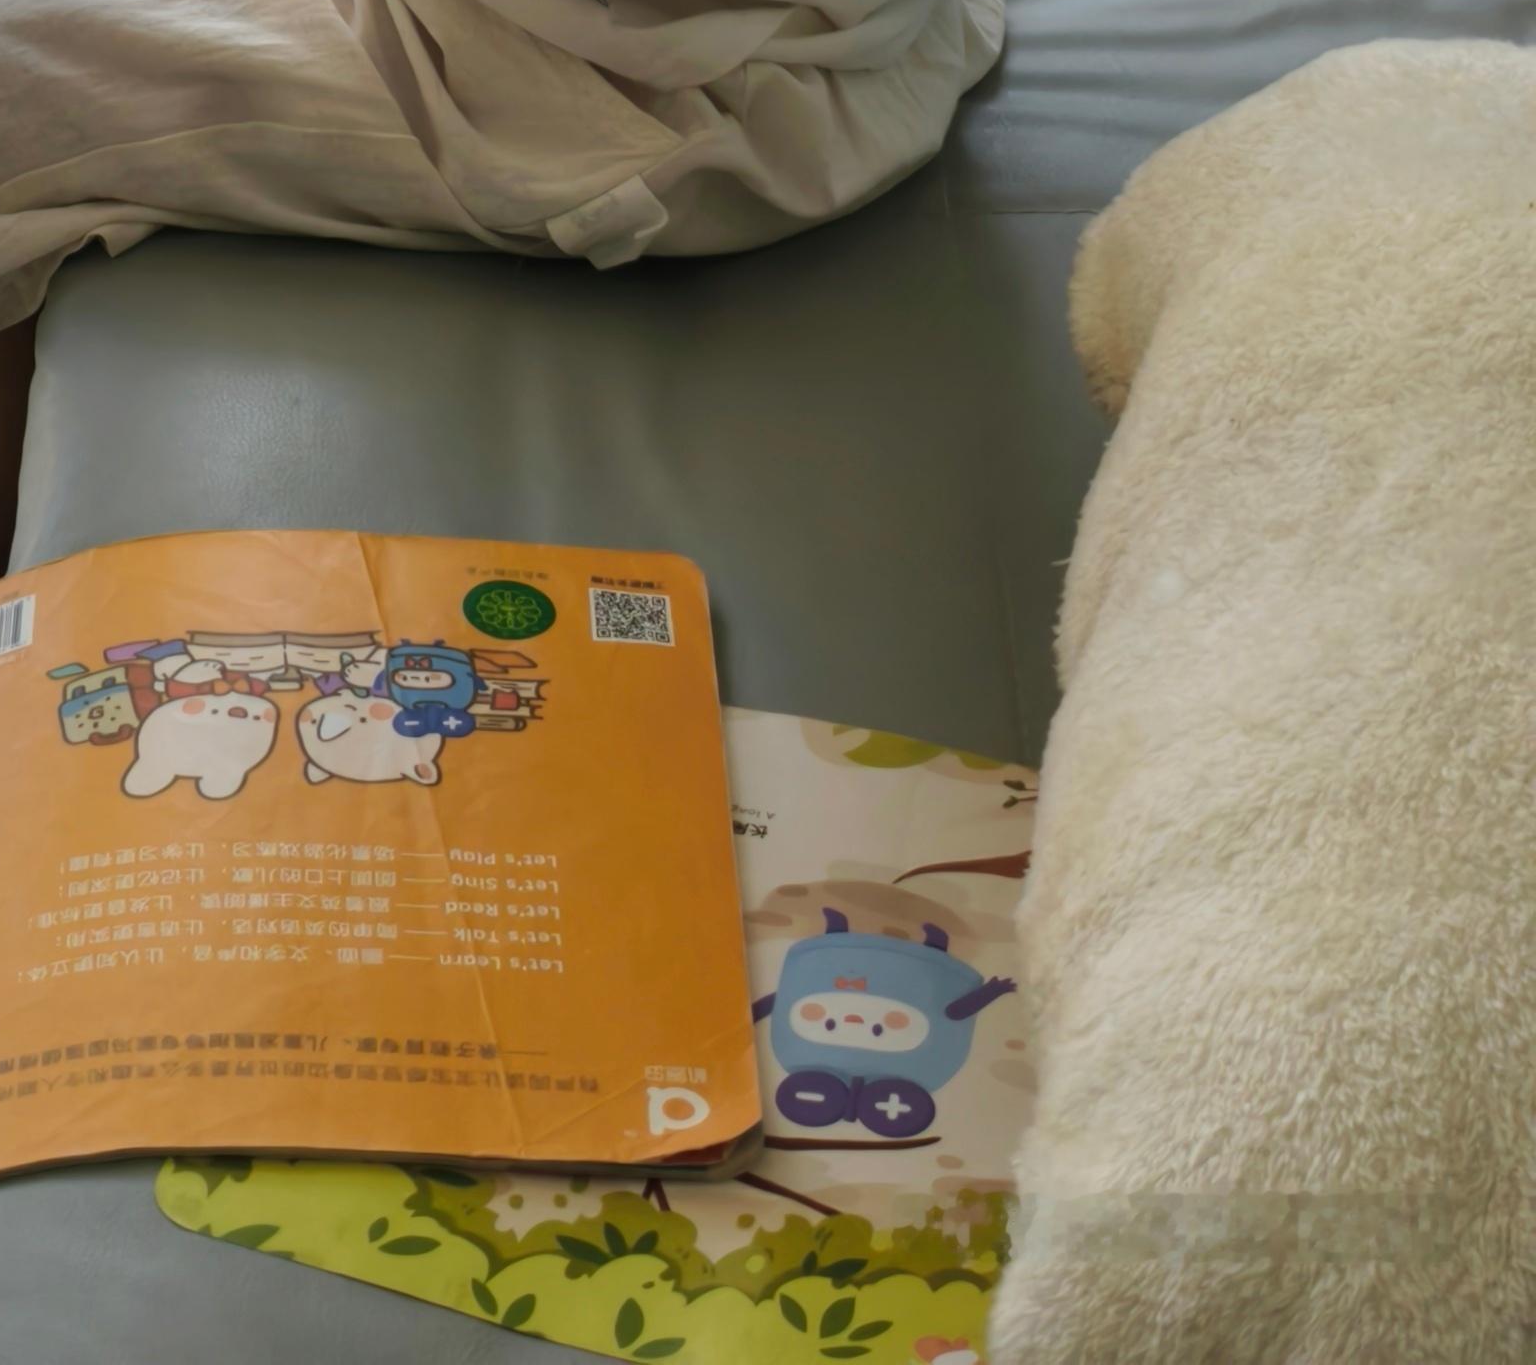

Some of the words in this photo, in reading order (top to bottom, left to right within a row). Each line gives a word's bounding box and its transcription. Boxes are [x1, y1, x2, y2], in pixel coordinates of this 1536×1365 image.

[449, 846, 496, 866] Play
[449, 872, 497, 891] Sing
[444, 900, 499, 918] Read
[453, 927, 500, 944] Talk
[439, 953, 501, 971] Learn
